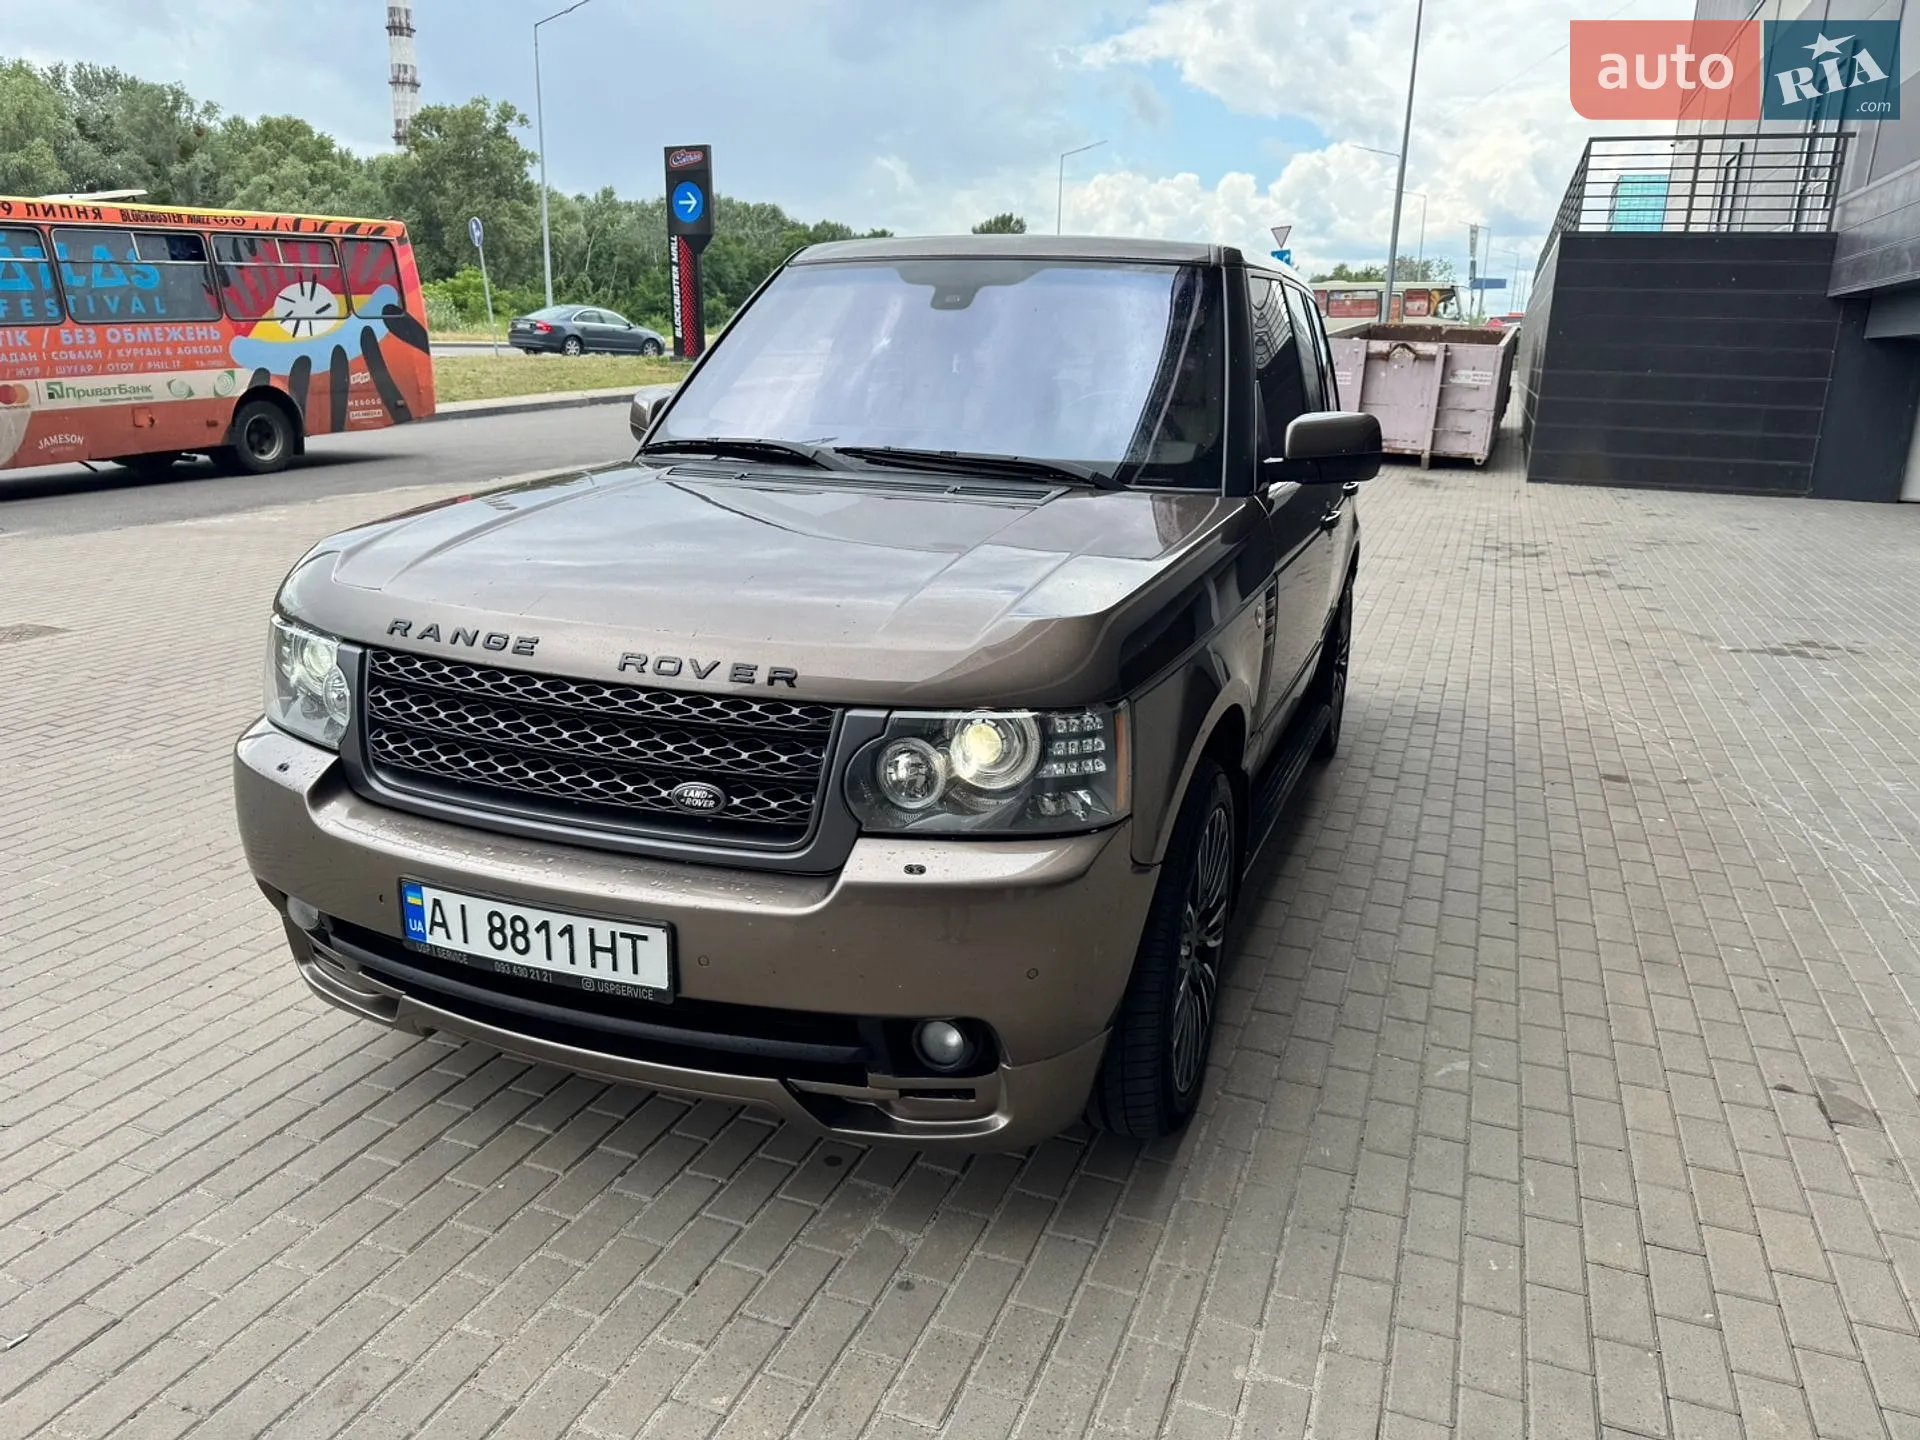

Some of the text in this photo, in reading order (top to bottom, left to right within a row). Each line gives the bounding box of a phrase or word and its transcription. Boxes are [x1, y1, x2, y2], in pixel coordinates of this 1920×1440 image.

[25, 202, 103, 220] ЛИПНЯ
[670, 235, 683, 338] BLOCKBUSTER MALL
[0, 294, 167, 319] FESTIVAL
[60, 328, 97, 346] БЕЗ
[106, 325, 221, 344] ОБМЕЖЕНЬ
[66, 383, 152, 400] ПриватБанк
[38, 433, 84, 450] JAMESON
[386, 617, 799, 688] RANGE ROVER
[409, 918, 425, 933] UA
[429, 897, 469, 944] AI
